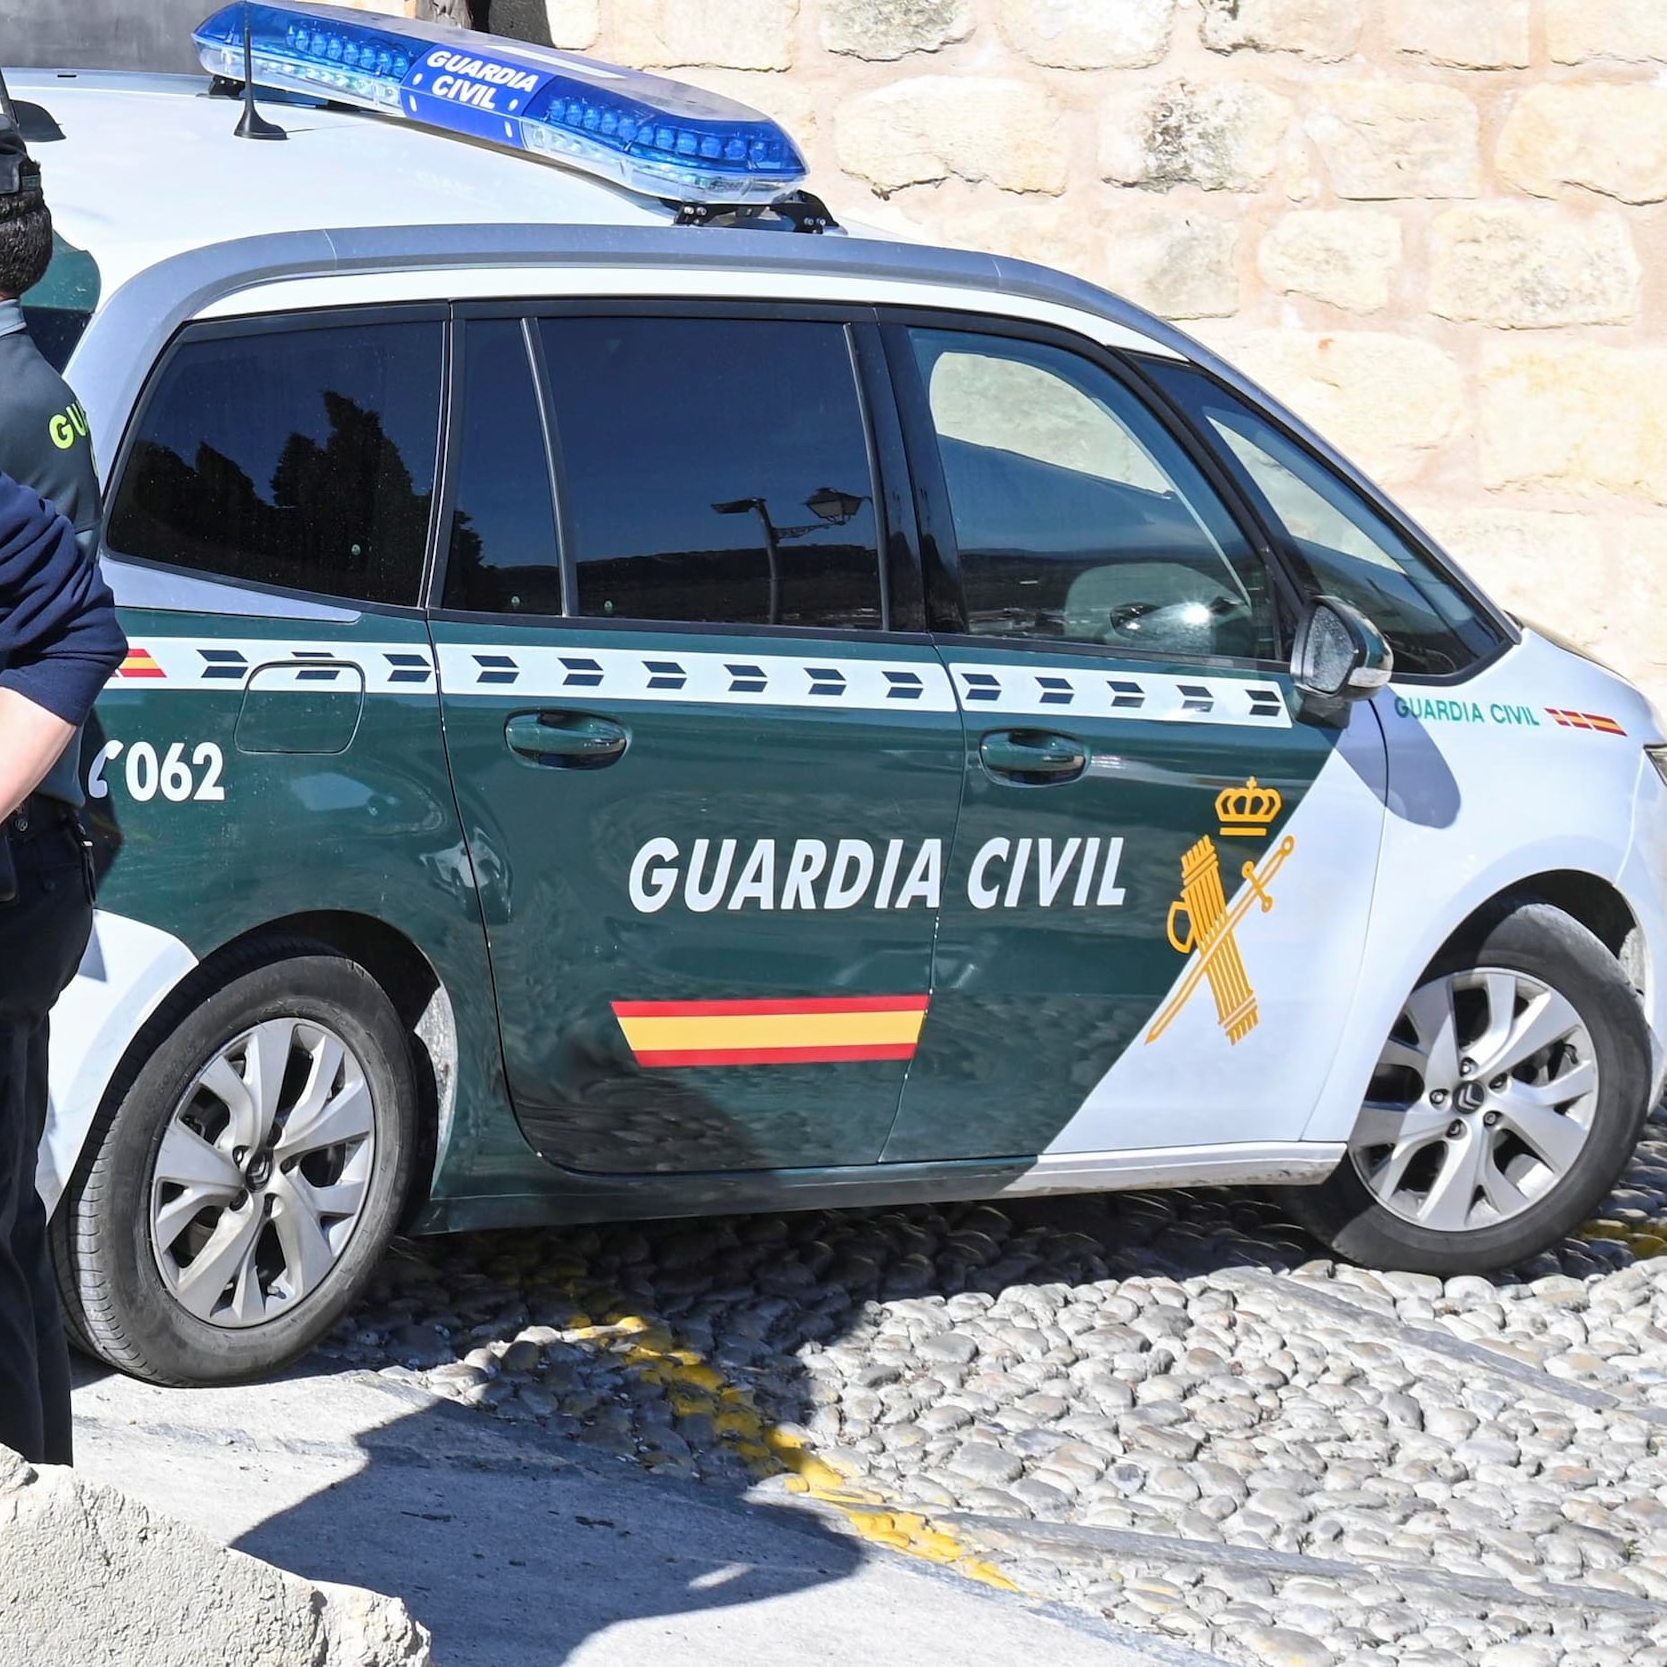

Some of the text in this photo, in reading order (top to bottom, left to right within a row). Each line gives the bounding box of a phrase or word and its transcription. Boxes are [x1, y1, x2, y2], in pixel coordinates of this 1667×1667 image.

[427, 50, 539, 92] GUARDIA
[431, 75, 497, 109] CIVIL
[49, 402, 87, 449] GU
[1394, 696, 1540, 726] GUARDIA CIVIL
[125, 741, 225, 802] 062
[628, 837, 1126, 913] GUARDIA CIVIL
